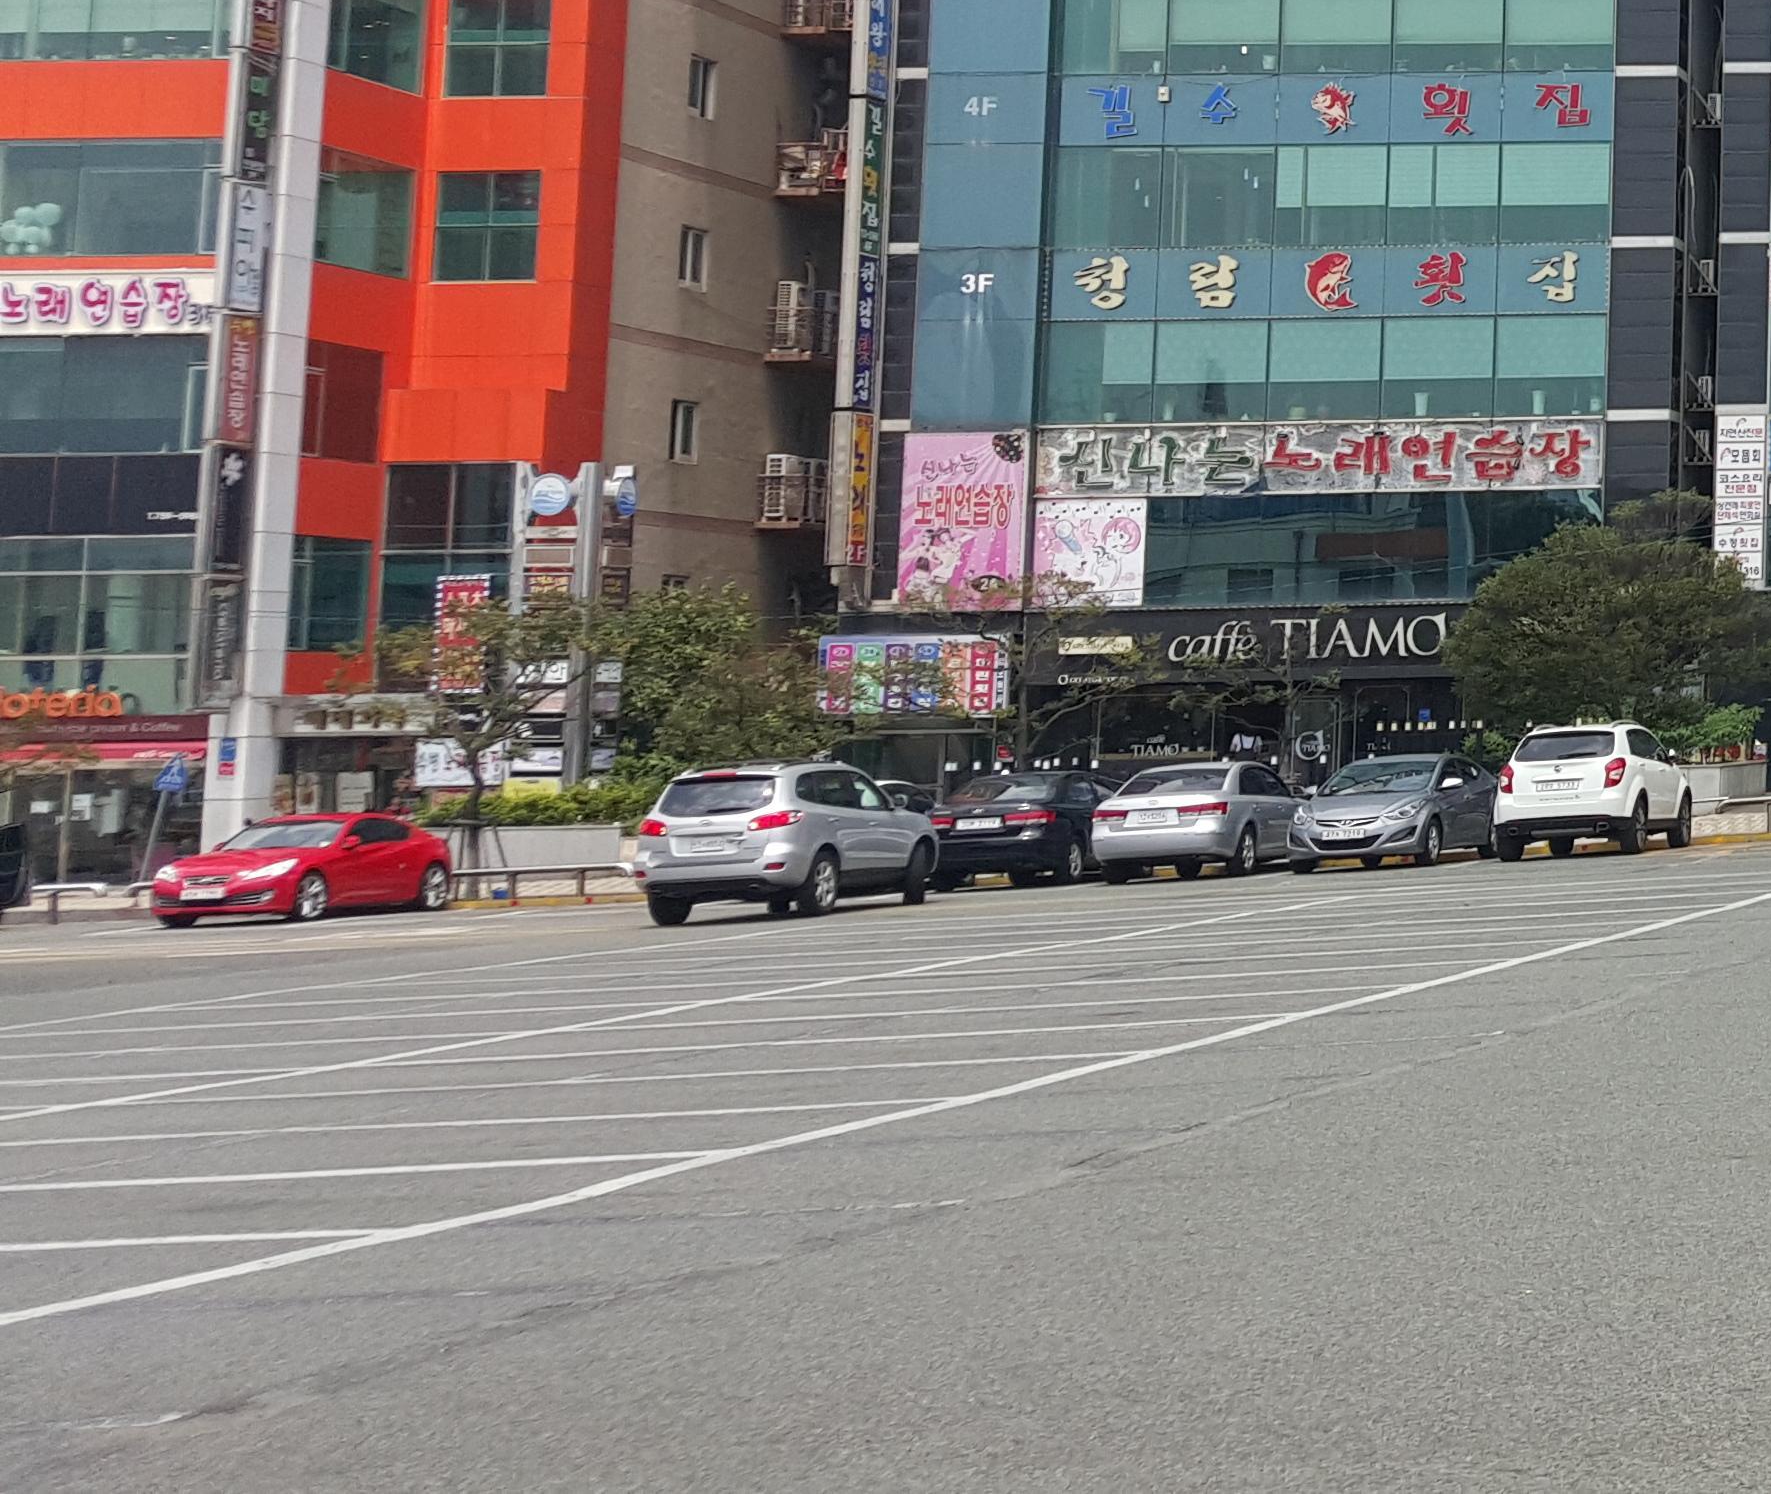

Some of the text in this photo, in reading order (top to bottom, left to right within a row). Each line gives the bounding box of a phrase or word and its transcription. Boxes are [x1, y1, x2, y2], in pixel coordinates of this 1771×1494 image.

[1422, 83, 1591, 136] 횟집
[960, 273, 994, 293] 3F
[1263, 428, 1591, 482] 노래연습장
[914, 482, 1014, 530] 노래연습장
[1271, 611, 1446, 659] TIAMO
